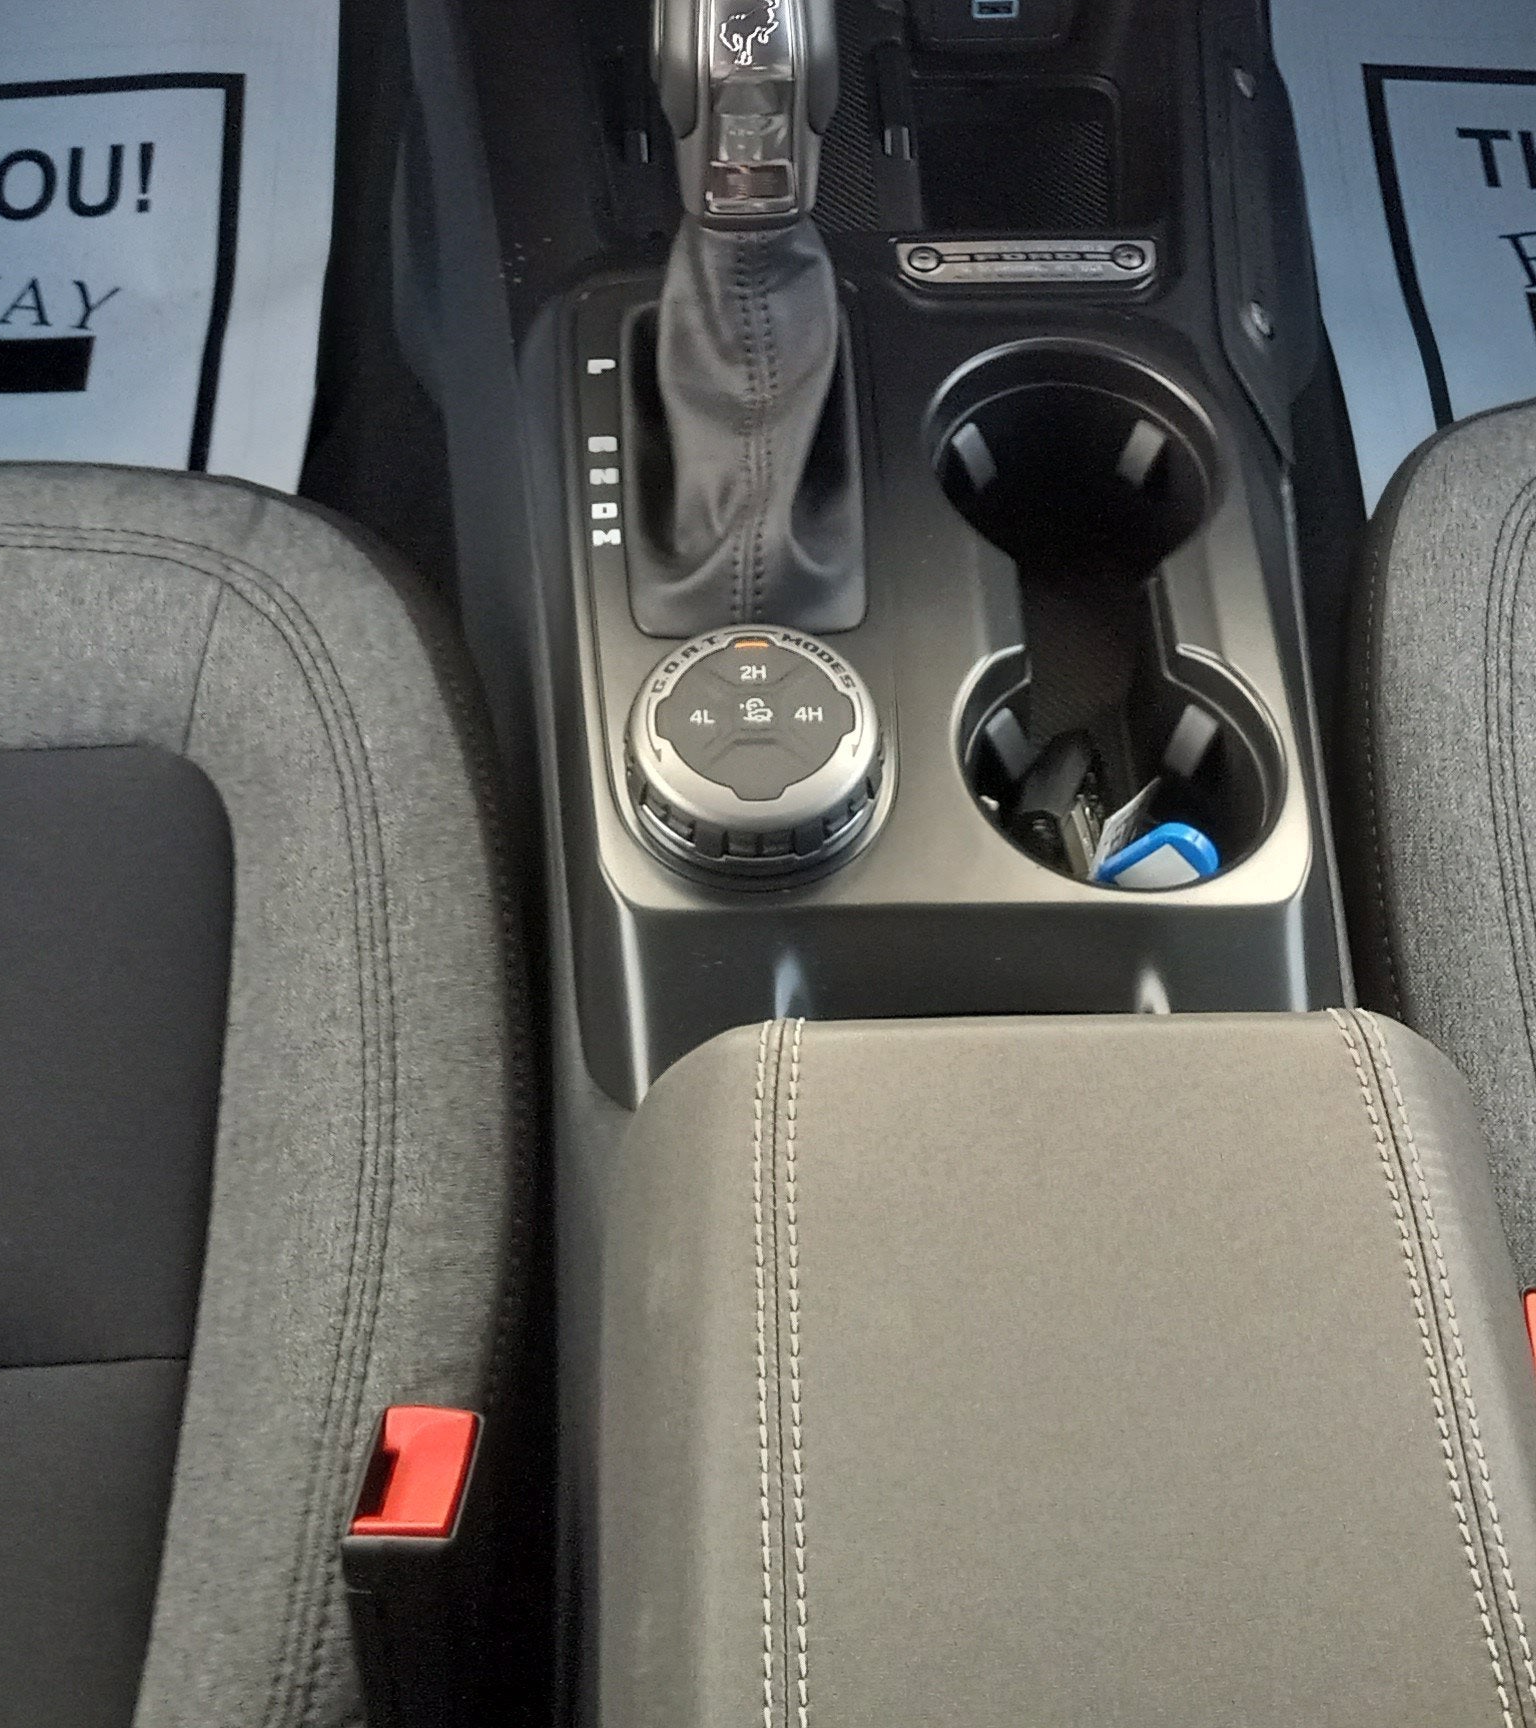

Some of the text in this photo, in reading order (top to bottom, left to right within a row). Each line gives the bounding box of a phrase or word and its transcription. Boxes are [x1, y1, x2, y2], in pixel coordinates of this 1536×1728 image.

[589, 468, 619, 485] N
[591, 502, 618, 519] D
[592, 529, 621, 546] M
[781, 633, 857, 689] MODES
[739, 665, 767, 681] 2H
[689, 709, 715, 724] 4L
[794, 706, 823, 722] 4H
